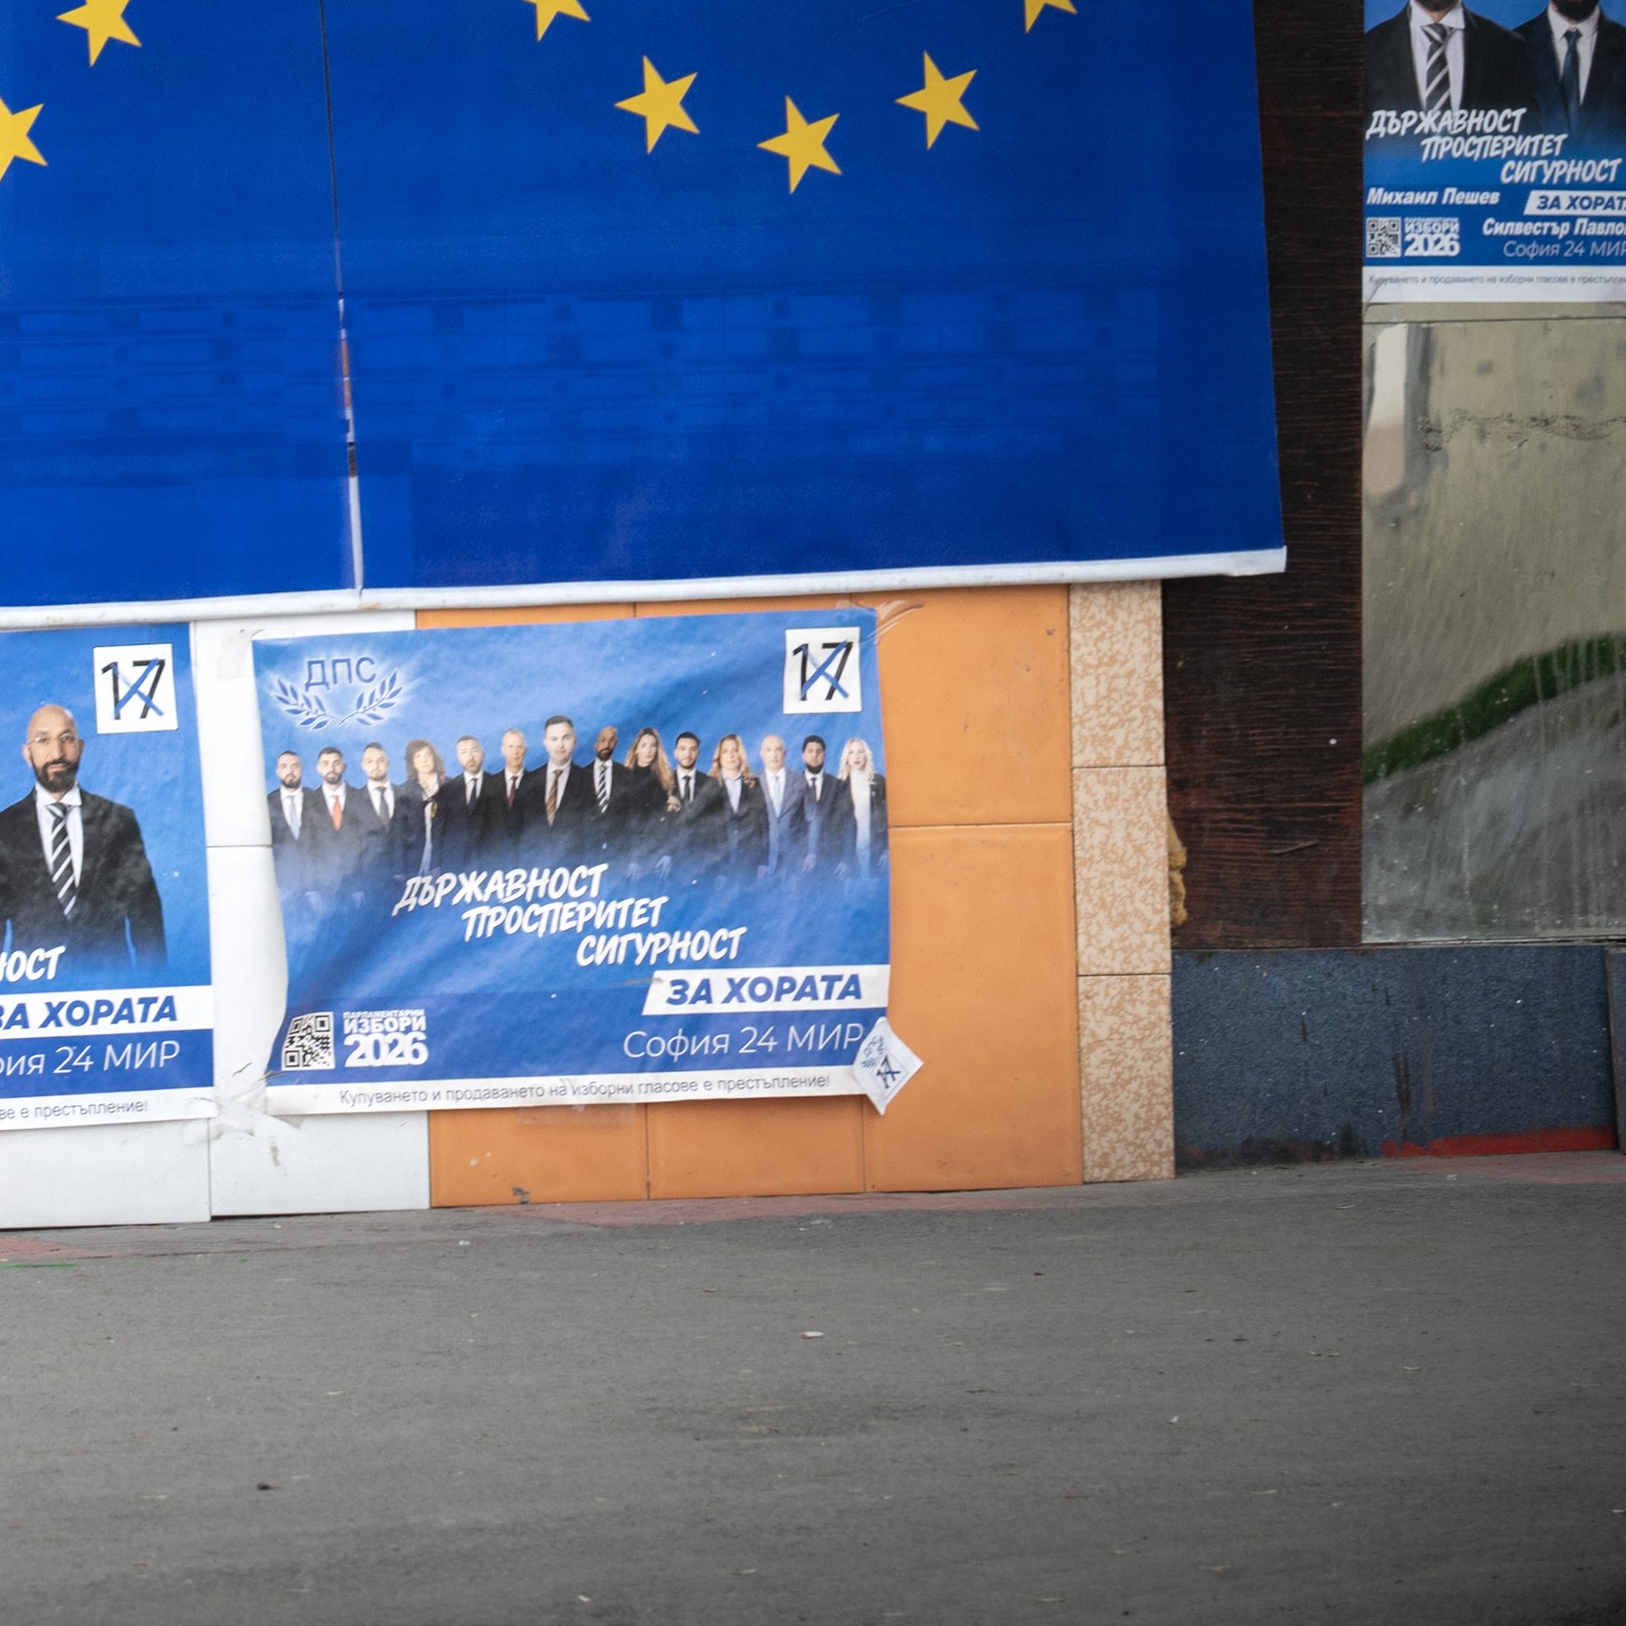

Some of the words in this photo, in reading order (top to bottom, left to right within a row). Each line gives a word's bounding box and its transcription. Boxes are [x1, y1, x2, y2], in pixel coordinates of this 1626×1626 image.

[1366, 107, 1527, 140] ДЪРЖАВНОСТ
[1420, 134, 1567, 162] ПРОСПЕРИТЕТ
[1500, 158, 1622, 185] СИГУРНОСТ
[1366, 187, 1439, 206] Михаил
[1441, 187, 1501, 206] Пешев
[1536, 195, 1562, 211] ЗА
[1565, 195, 1626, 211] ХОРАТ
[1482, 217, 1569, 239] Силвестър
[1573, 217, 1626, 236] Павло
[1404, 233, 1461, 257] 2026
[1503, 240, 1560, 260] София
[1563, 240, 1586, 257] 24
[304, 656, 377, 691] ДПС
[792, 640, 853, 702] 17
[101, 658, 166, 721] 17
[392, 863, 609, 917] ДЪРЖАВНОСТ
[461, 896, 668, 942] ПРОСПЕРИТЕТ
[575, 926, 746, 969] СИГУРНОСТ
[665, 978, 713, 1006] ЗА
[721, 973, 863, 1005] ХОРАТА
[38, 994, 178, 1030] ХОРАТА
[343, 1016, 427, 1035] ИЗБОРИ
[53, 1045, 94, 1074] 24
[103, 1040, 181, 1071] МИР
[343, 1031, 429, 1068] 2026
[623, 1028, 729, 1063] София
[738, 1027, 778, 1054] 24
[786, 1023, 864, 1052] МИР
[339, 1089, 428, 1107] Купуването
[433, 1090, 441, 1101] и
[447, 1085, 545, 1104] продаването
[549, 1085, 567, 1097] на
[571, 1079, 634, 1099] изборни
[638, 1079, 698, 1095] гласове
[703, 1080, 713, 1091] е
[717, 1075, 831, 1094] престъпление!
[20, 1108, 29, 1120] е
[34, 1100, 148, 1122] престъпление!
